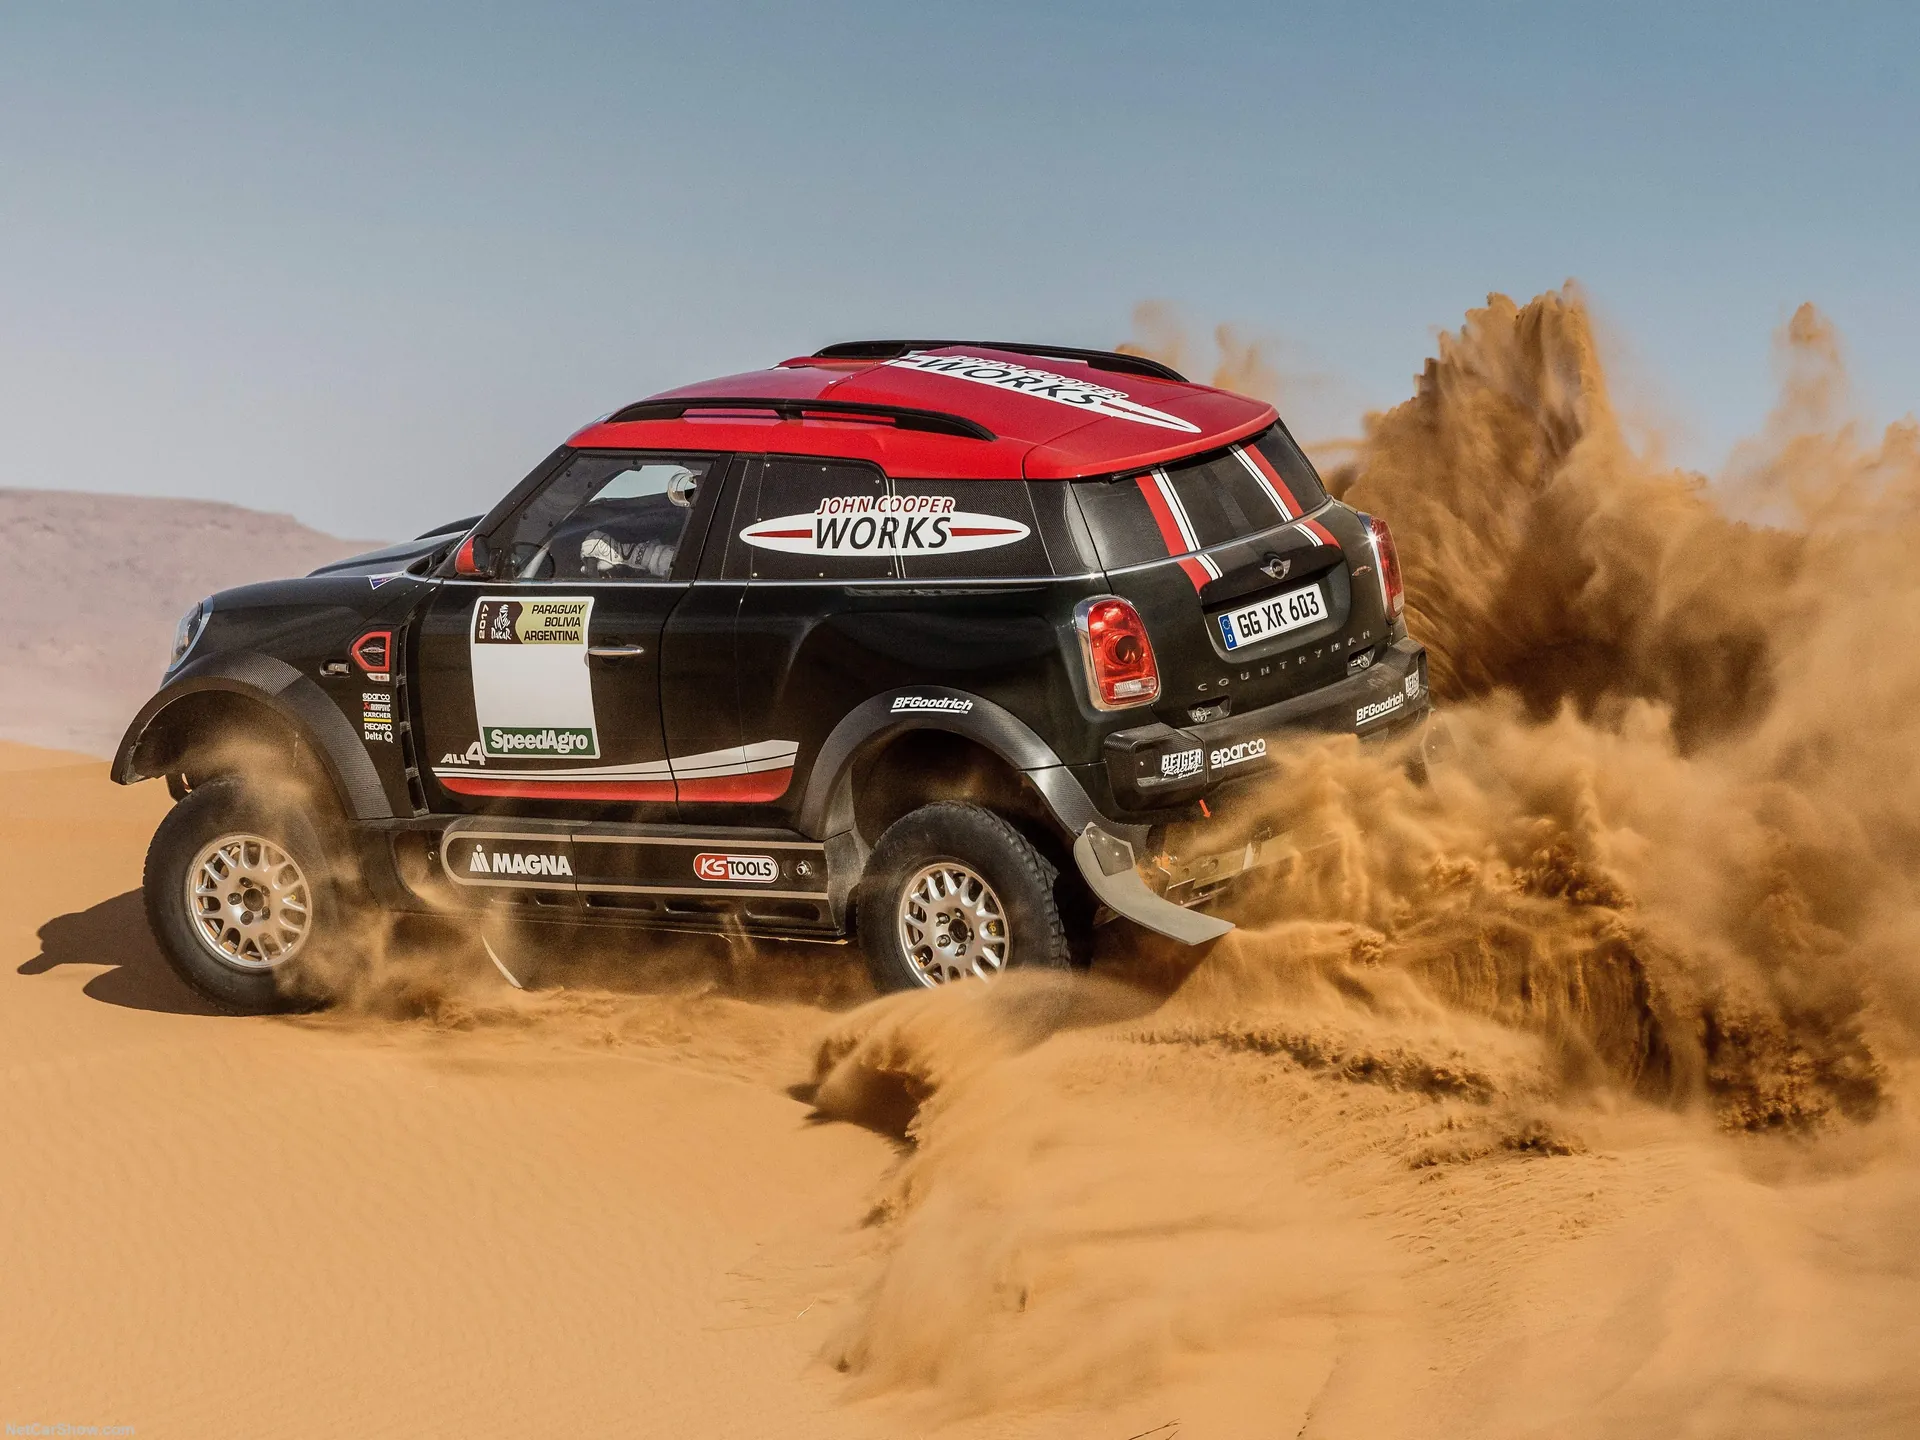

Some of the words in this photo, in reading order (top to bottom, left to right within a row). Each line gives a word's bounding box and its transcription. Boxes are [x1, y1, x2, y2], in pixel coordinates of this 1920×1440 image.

[917, 359, 1110, 404] WORKS
[1023, 369, 1129, 399] COOPER
[817, 498, 871, 515] JOHN
[878, 497, 954, 513] COOPER
[816, 516, 951, 550] WORKS
[479, 604, 489, 639] 2017
[531, 604, 585, 615] PARAGUAY
[1236, 610, 1263, 638] GG
[1262, 602, 1288, 630] XR
[1289, 591, 1320, 621] 603
[544, 617, 581, 627] BOLIVIA
[523, 630, 580, 641] ARGENTINA
[1227, 634, 1234, 642] D
[1197, 630, 1370, 692] COUNTRYMAN
[891, 696, 974, 711] BFGoodrich
[1356, 691, 1404, 722] BFGoodrich
[364, 723, 392, 731] RECARO
[365, 731, 383, 740] Delta
[383, 731, 393, 743] Q
[440, 741, 486, 766] ALL4
[490, 729, 588, 754] SpeedAgro
[1210, 738, 1266, 768] sparco
[492, 852, 573, 876] MAGNA
[727, 861, 772, 876] TOOLS
